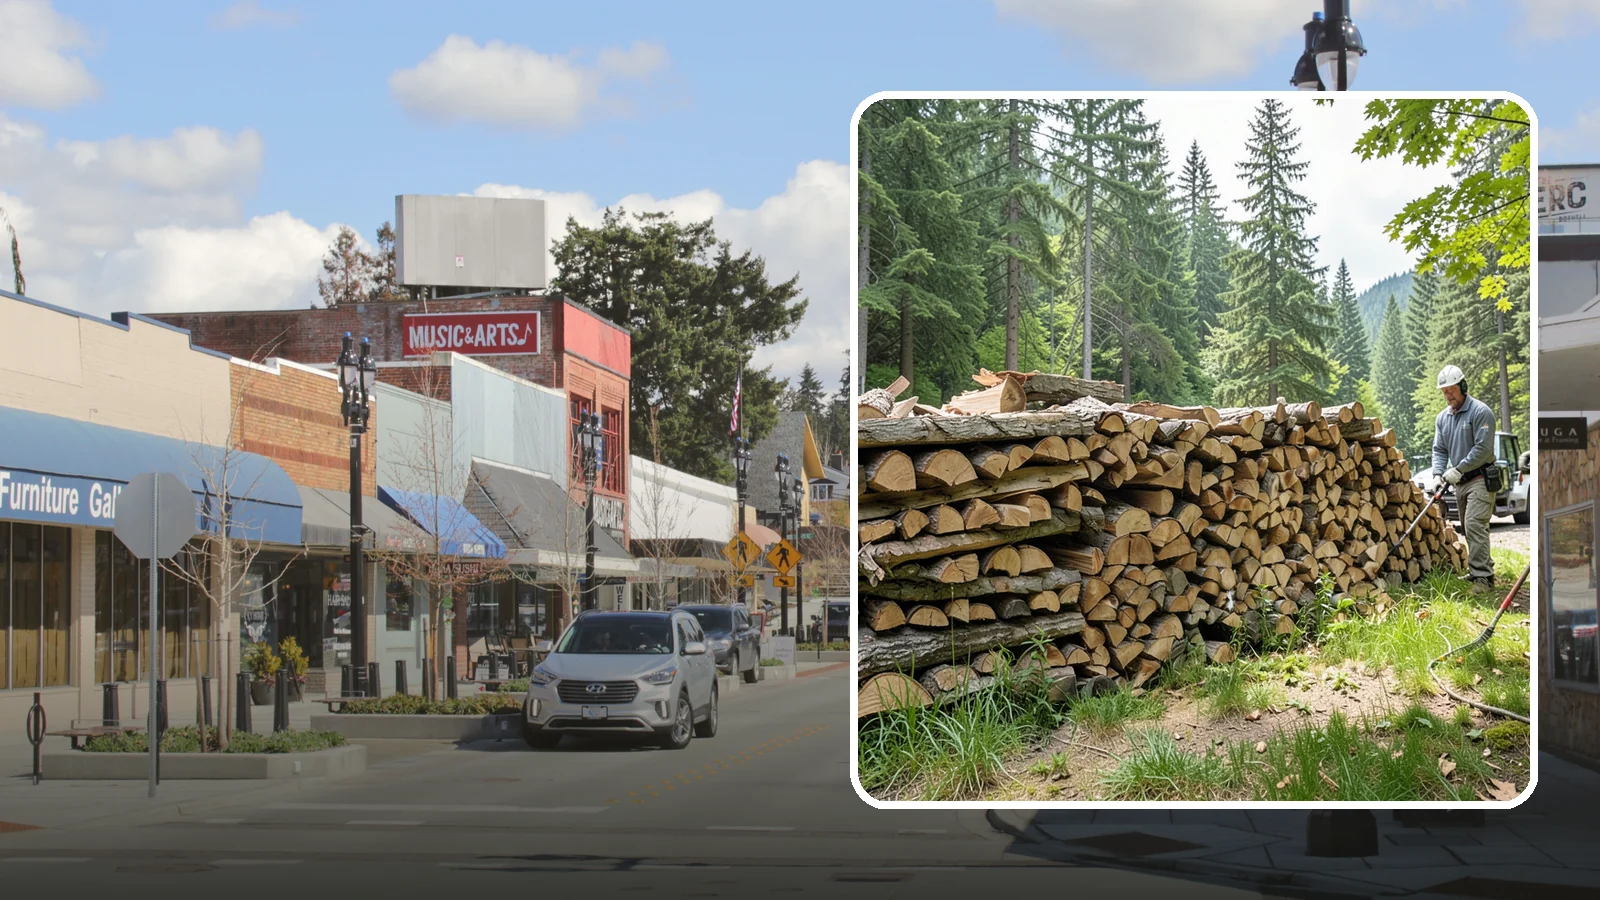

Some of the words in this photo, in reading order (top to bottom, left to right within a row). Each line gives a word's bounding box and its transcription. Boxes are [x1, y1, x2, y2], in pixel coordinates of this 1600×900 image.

[408, 322, 519, 349] MUSIC&ARTS
[1540, 427, 1577, 436] UGA
[0, 471, 80, 516] Furniture
[89, 482, 121, 519] Gal
[453, 563, 479, 574] SUSHI
